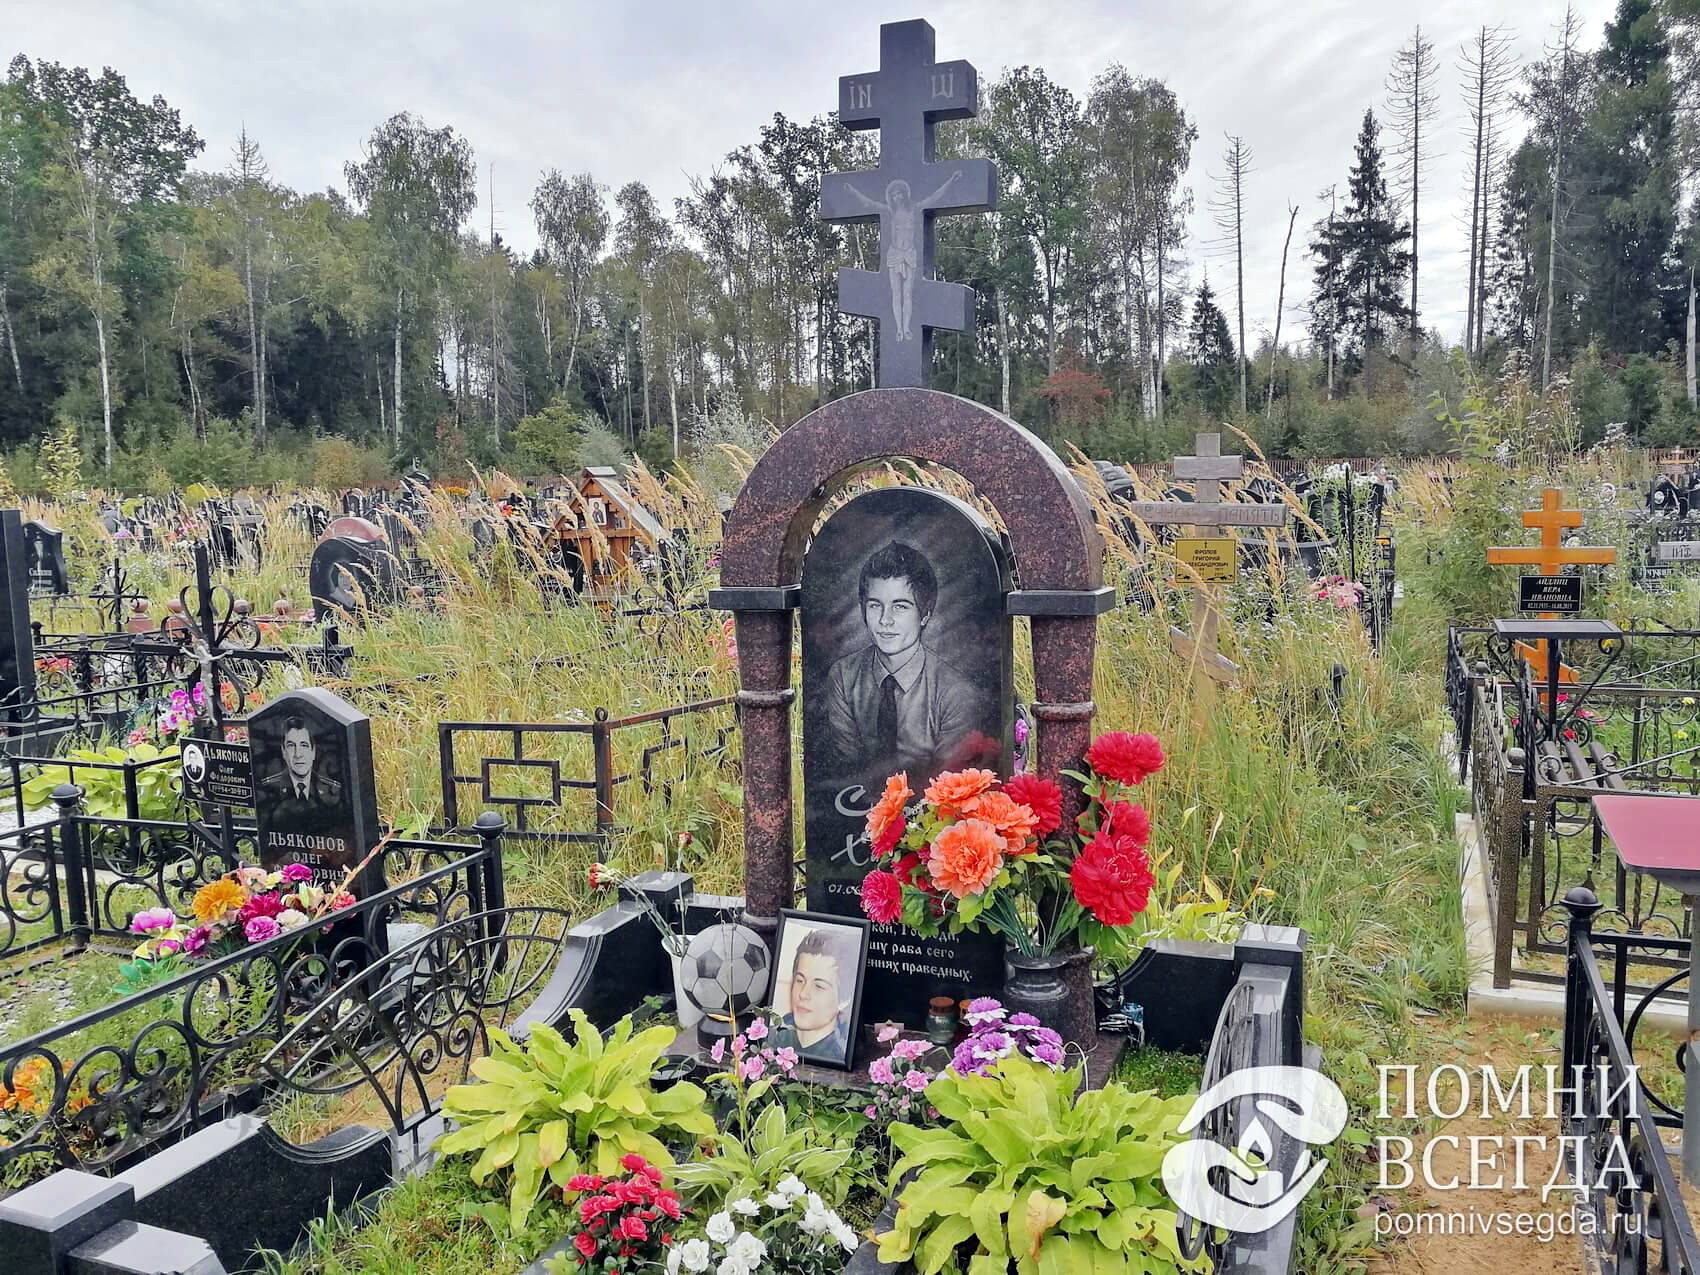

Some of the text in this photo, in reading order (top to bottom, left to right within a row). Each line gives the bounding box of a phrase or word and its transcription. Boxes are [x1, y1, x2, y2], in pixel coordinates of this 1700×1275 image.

[268, 831, 346, 852] ДЬЯКОНОВ
[292, 851, 322, 865] ОЛЕГ
[273, 863, 345, 881] ФОВИЧ
